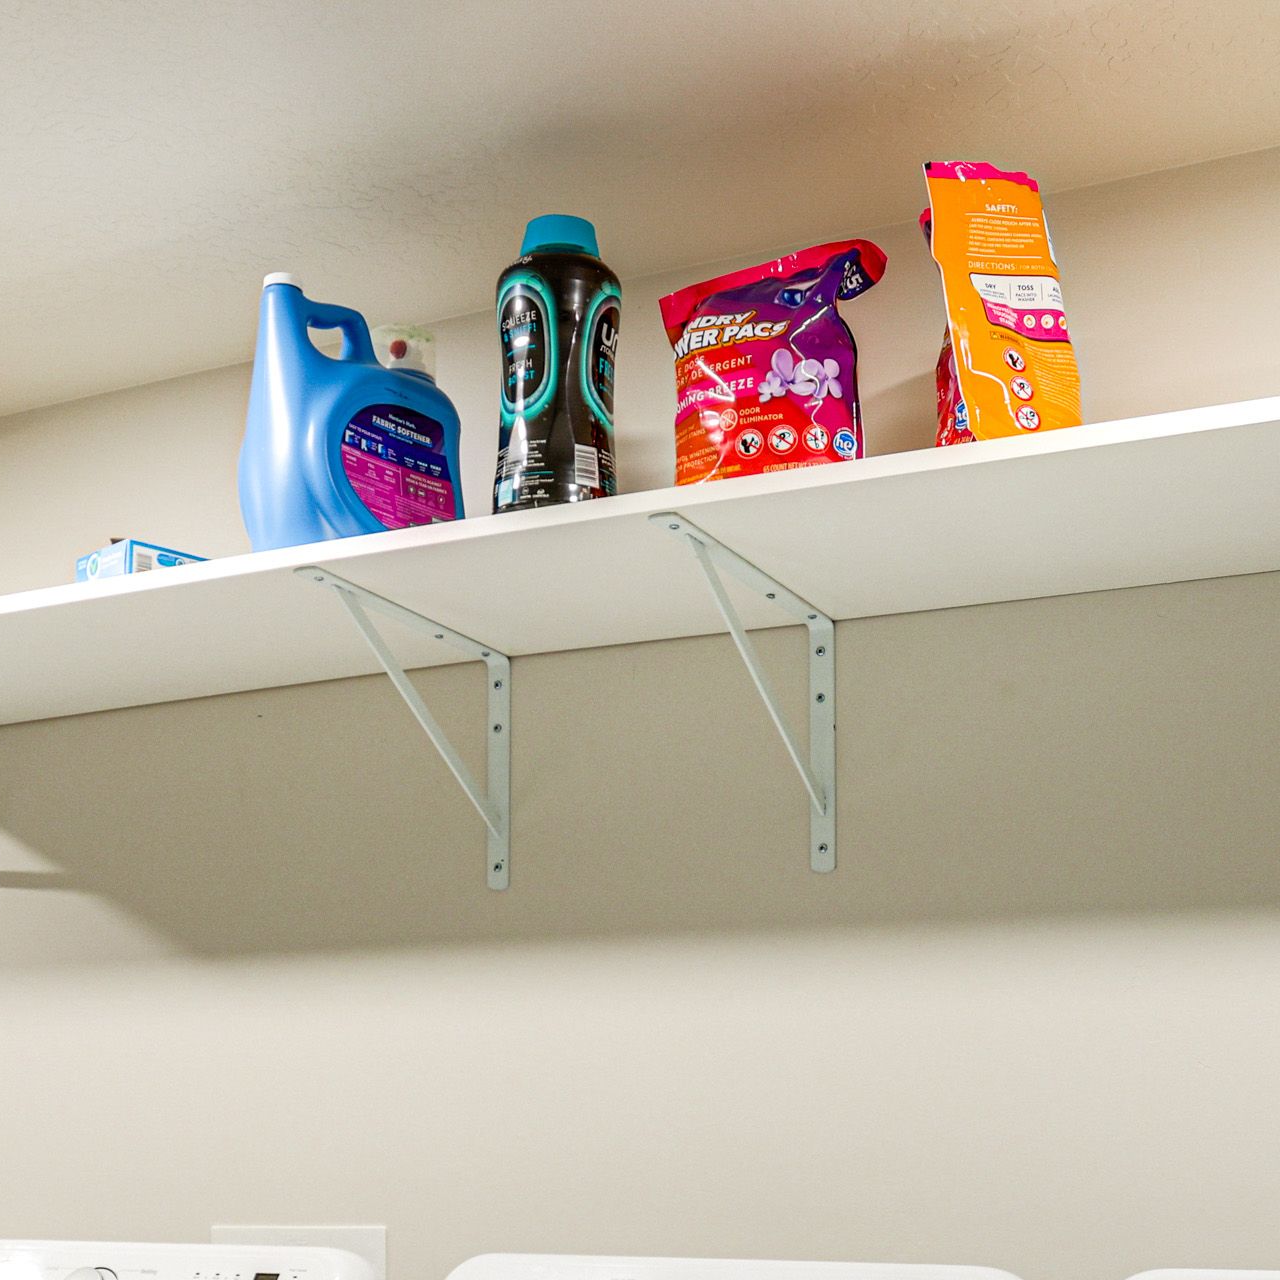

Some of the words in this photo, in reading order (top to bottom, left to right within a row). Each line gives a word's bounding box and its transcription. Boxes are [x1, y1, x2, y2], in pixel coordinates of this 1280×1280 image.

[985, 204, 1018, 214] SAFETY:
[968, 261, 1018, 271] DIRECTIONS:
[501, 310, 537, 332] SQUEEZE
[722, 320, 788, 343] PACS
[739, 406, 761, 416] ODOR
[739, 413, 784, 425] ELIMINATOR
[371, 415, 397, 432] FABRIC
[396, 425, 434, 444] SOFTENER
